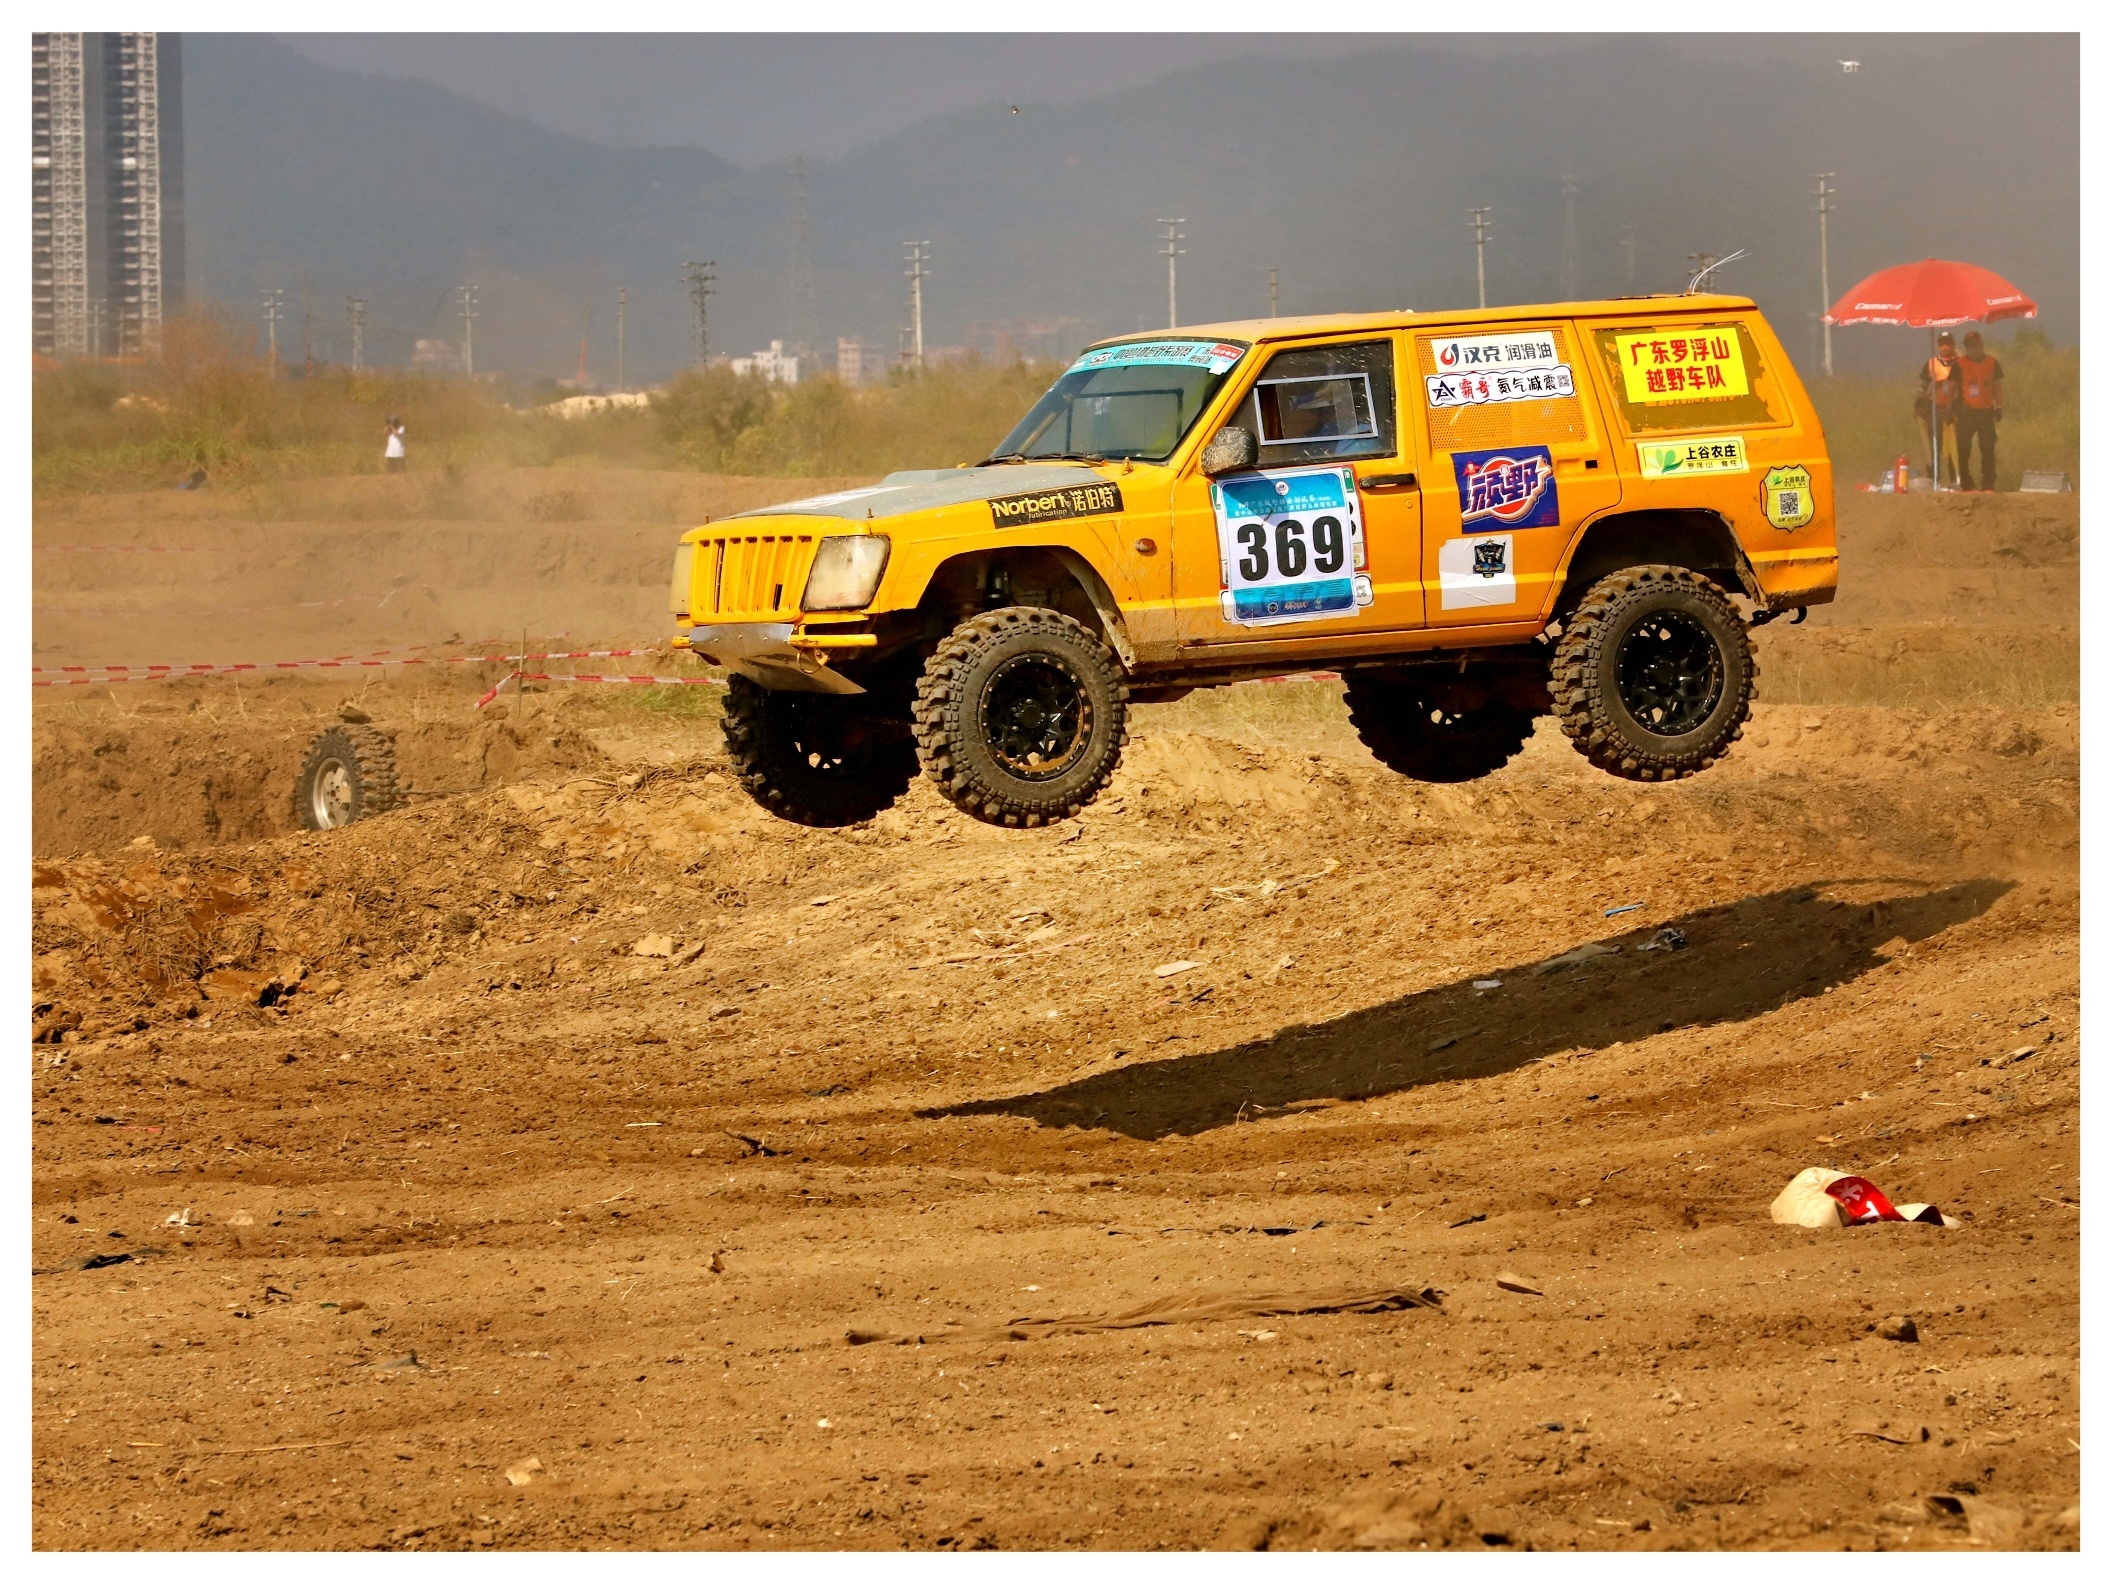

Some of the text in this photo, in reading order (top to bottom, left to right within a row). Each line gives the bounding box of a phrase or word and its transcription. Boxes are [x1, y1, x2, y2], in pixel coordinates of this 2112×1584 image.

[1463, 342, 1553, 364] 汉克 润滑油
[1630, 336, 1730, 366] 广东罗浮山
[1459, 375, 1558, 399] 霸哥 氮气减震
[1646, 364, 1726, 393] 越野车队
[1685, 444, 1737, 460] 上谷农庄
[991, 486, 1115, 518] Norbert 诺伯特
[1028, 508, 1068, 519] lubrication
[1237, 516, 1344, 581] 369
